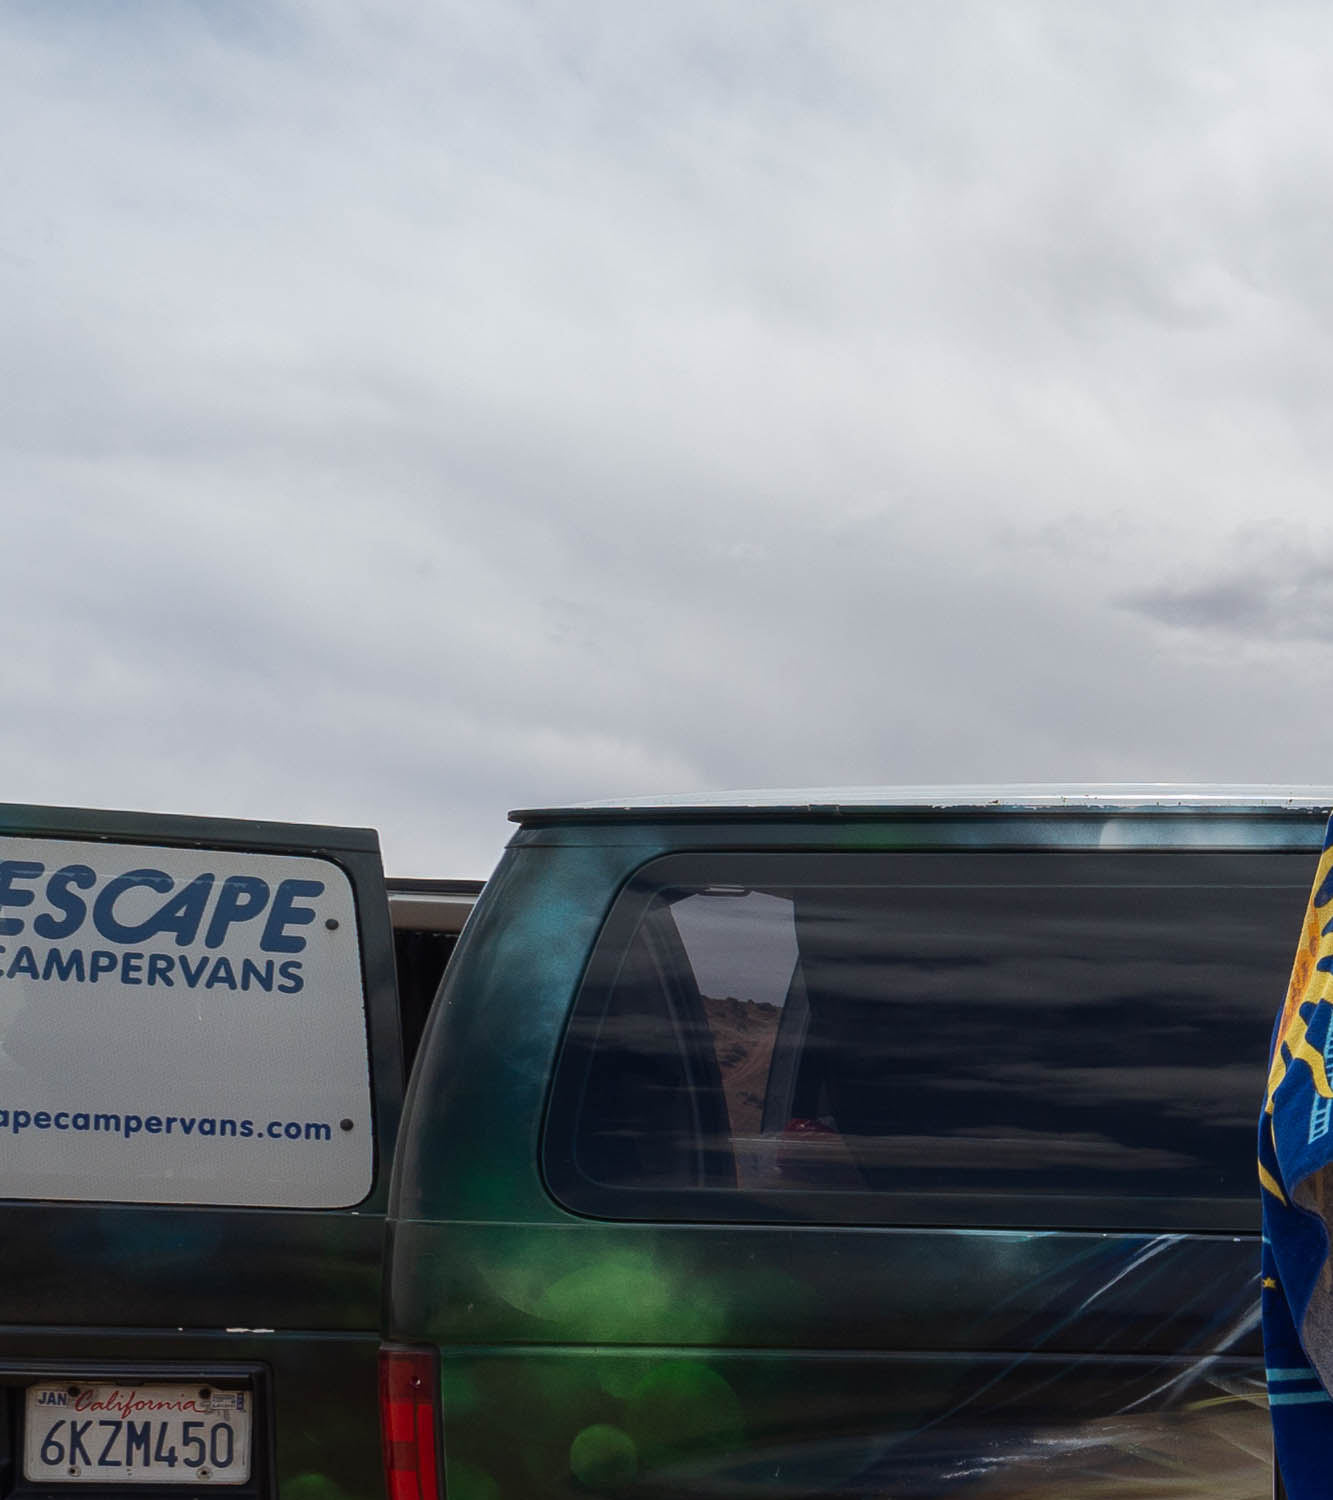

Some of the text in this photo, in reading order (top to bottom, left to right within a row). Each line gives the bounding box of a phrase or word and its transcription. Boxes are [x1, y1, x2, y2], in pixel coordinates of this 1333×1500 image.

[0, 860, 325, 953] ESCAPE
[0, 945, 304, 994] AMPERVANS
[38, 1392, 67, 1405] JAN
[74, 1389, 208, 1419] California
[40, 1420, 234, 1468] 6KZM450
